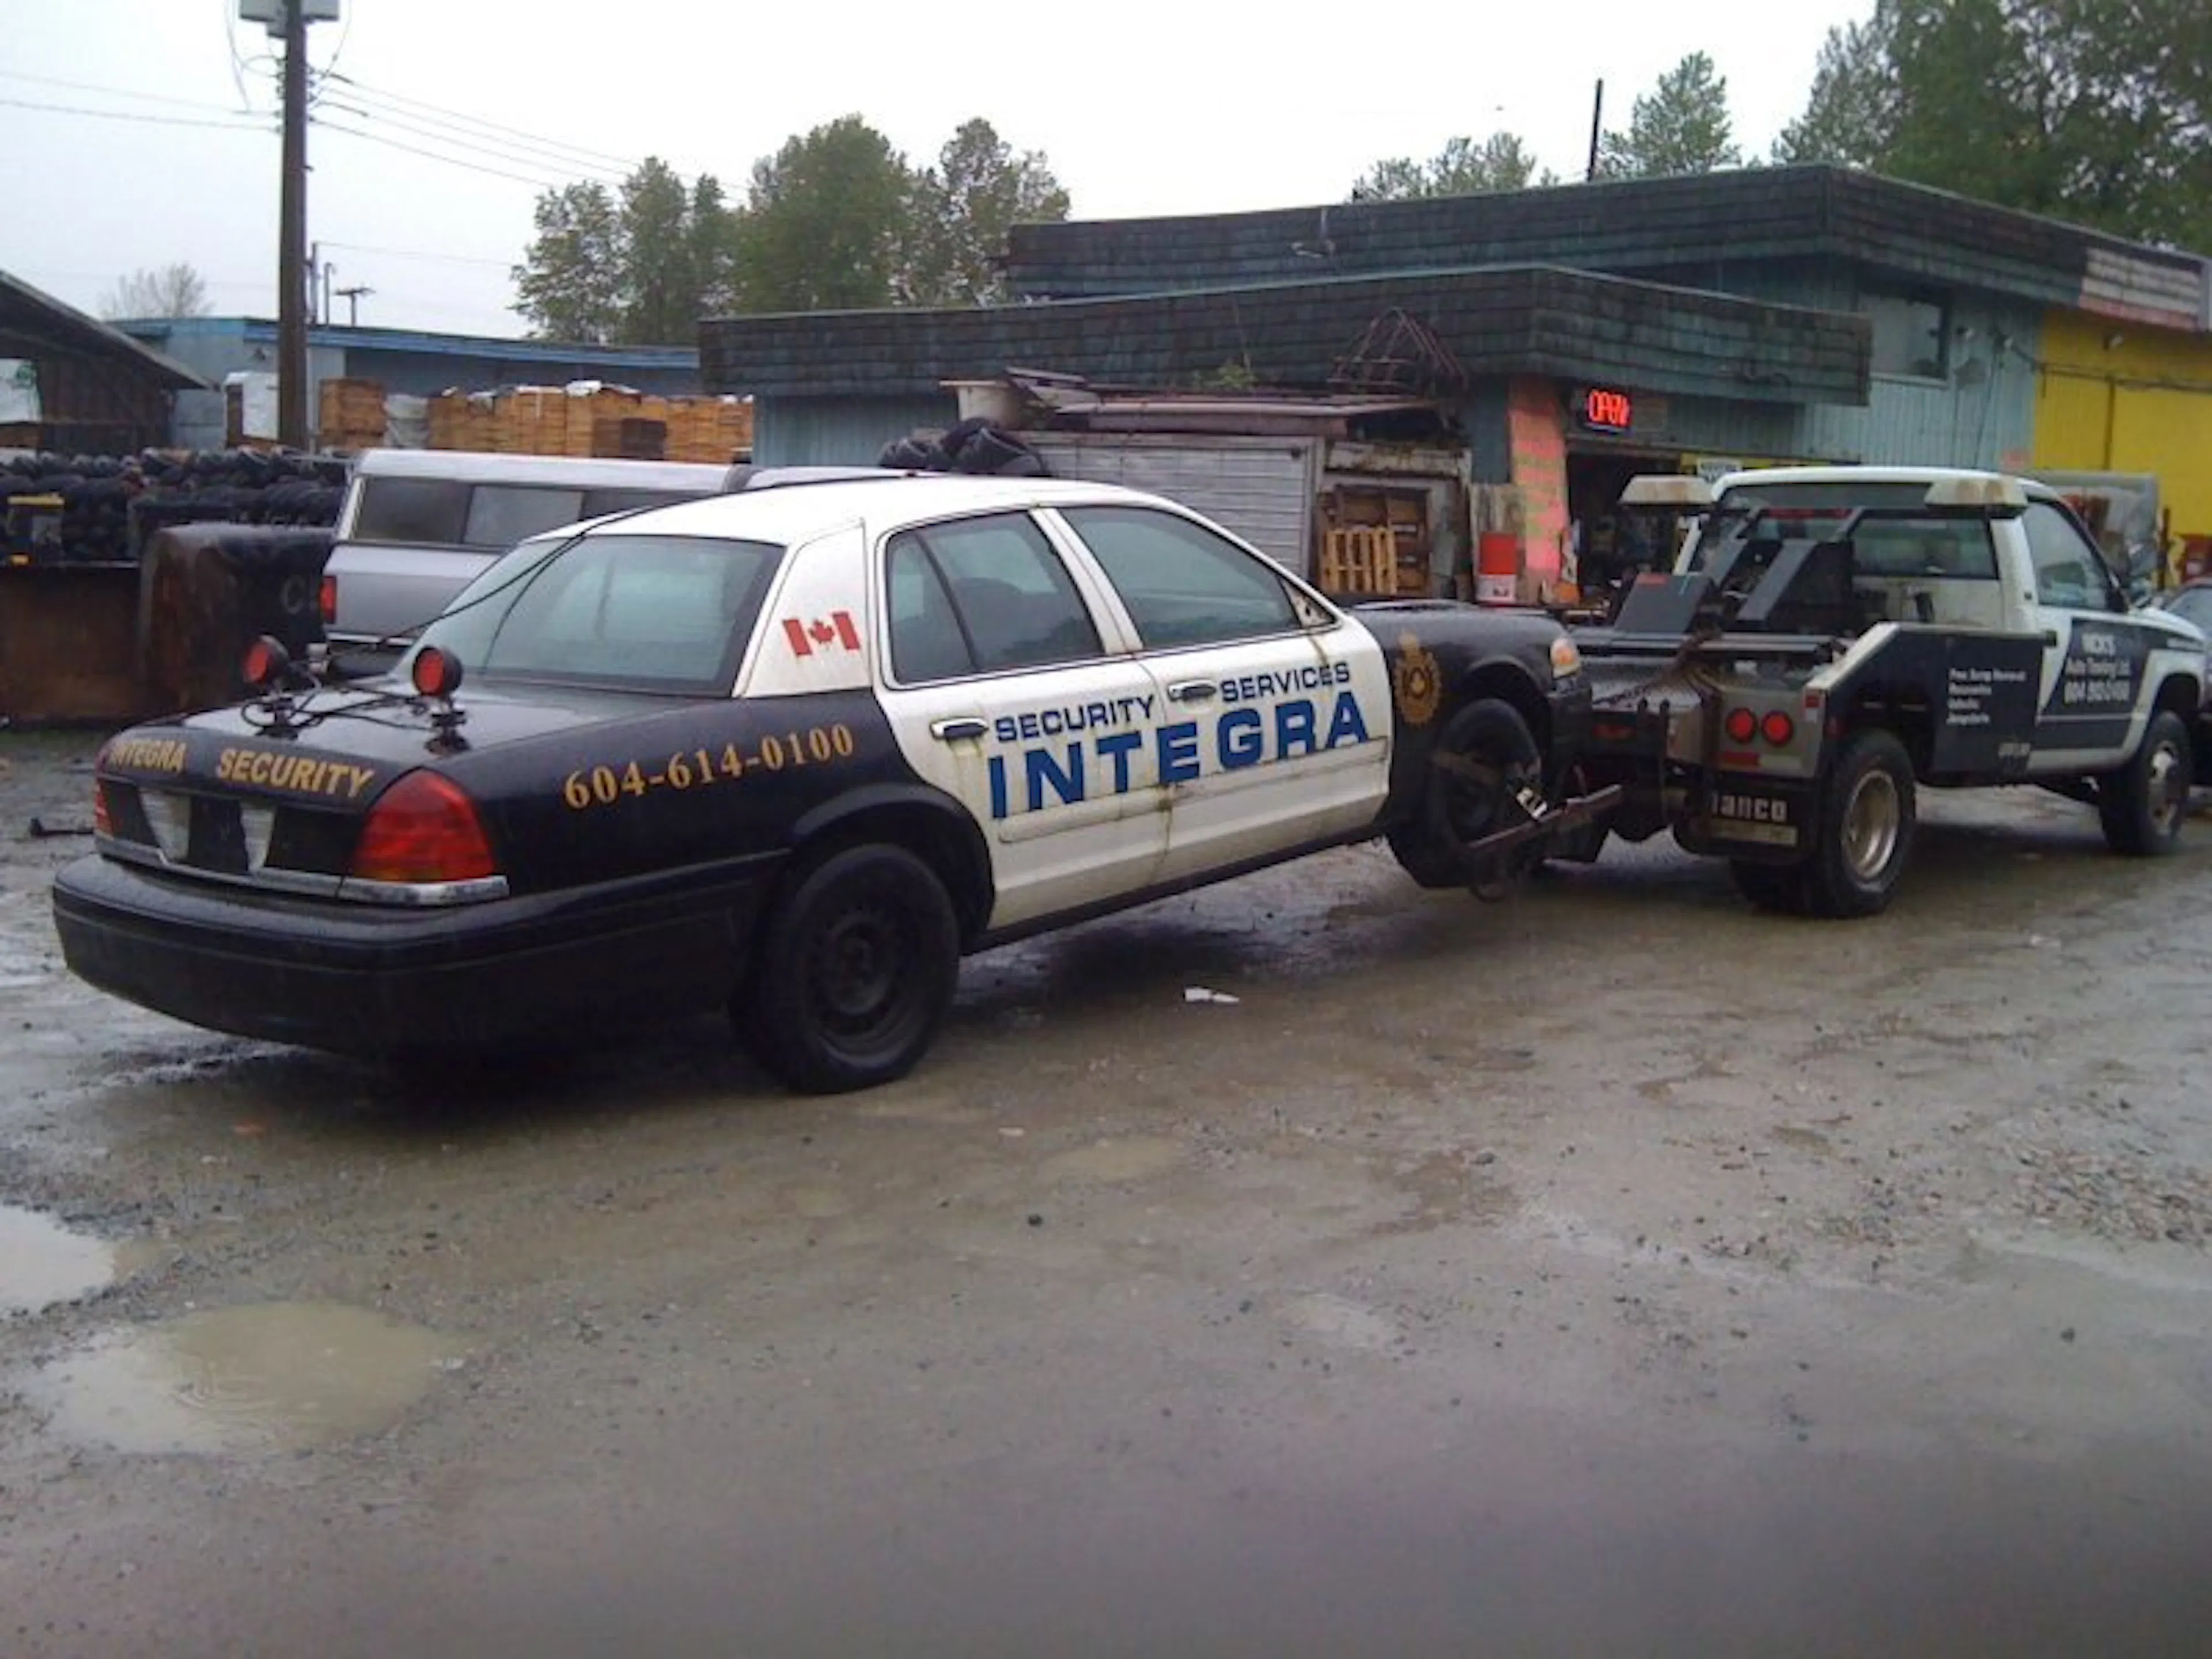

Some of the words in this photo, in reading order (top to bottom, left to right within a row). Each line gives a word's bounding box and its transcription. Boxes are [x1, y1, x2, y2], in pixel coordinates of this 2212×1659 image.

[1588, 389, 1631, 427] OPEN
[995, 695, 1153, 743] SECURITY
[1221, 661, 1350, 702] SERVICES
[108, 738, 187, 774] INTEGRA
[216, 747, 374, 798] SECURITY
[564, 724, 854, 809] 604-614-0100
[988, 691, 1368, 819] INTEGRA
